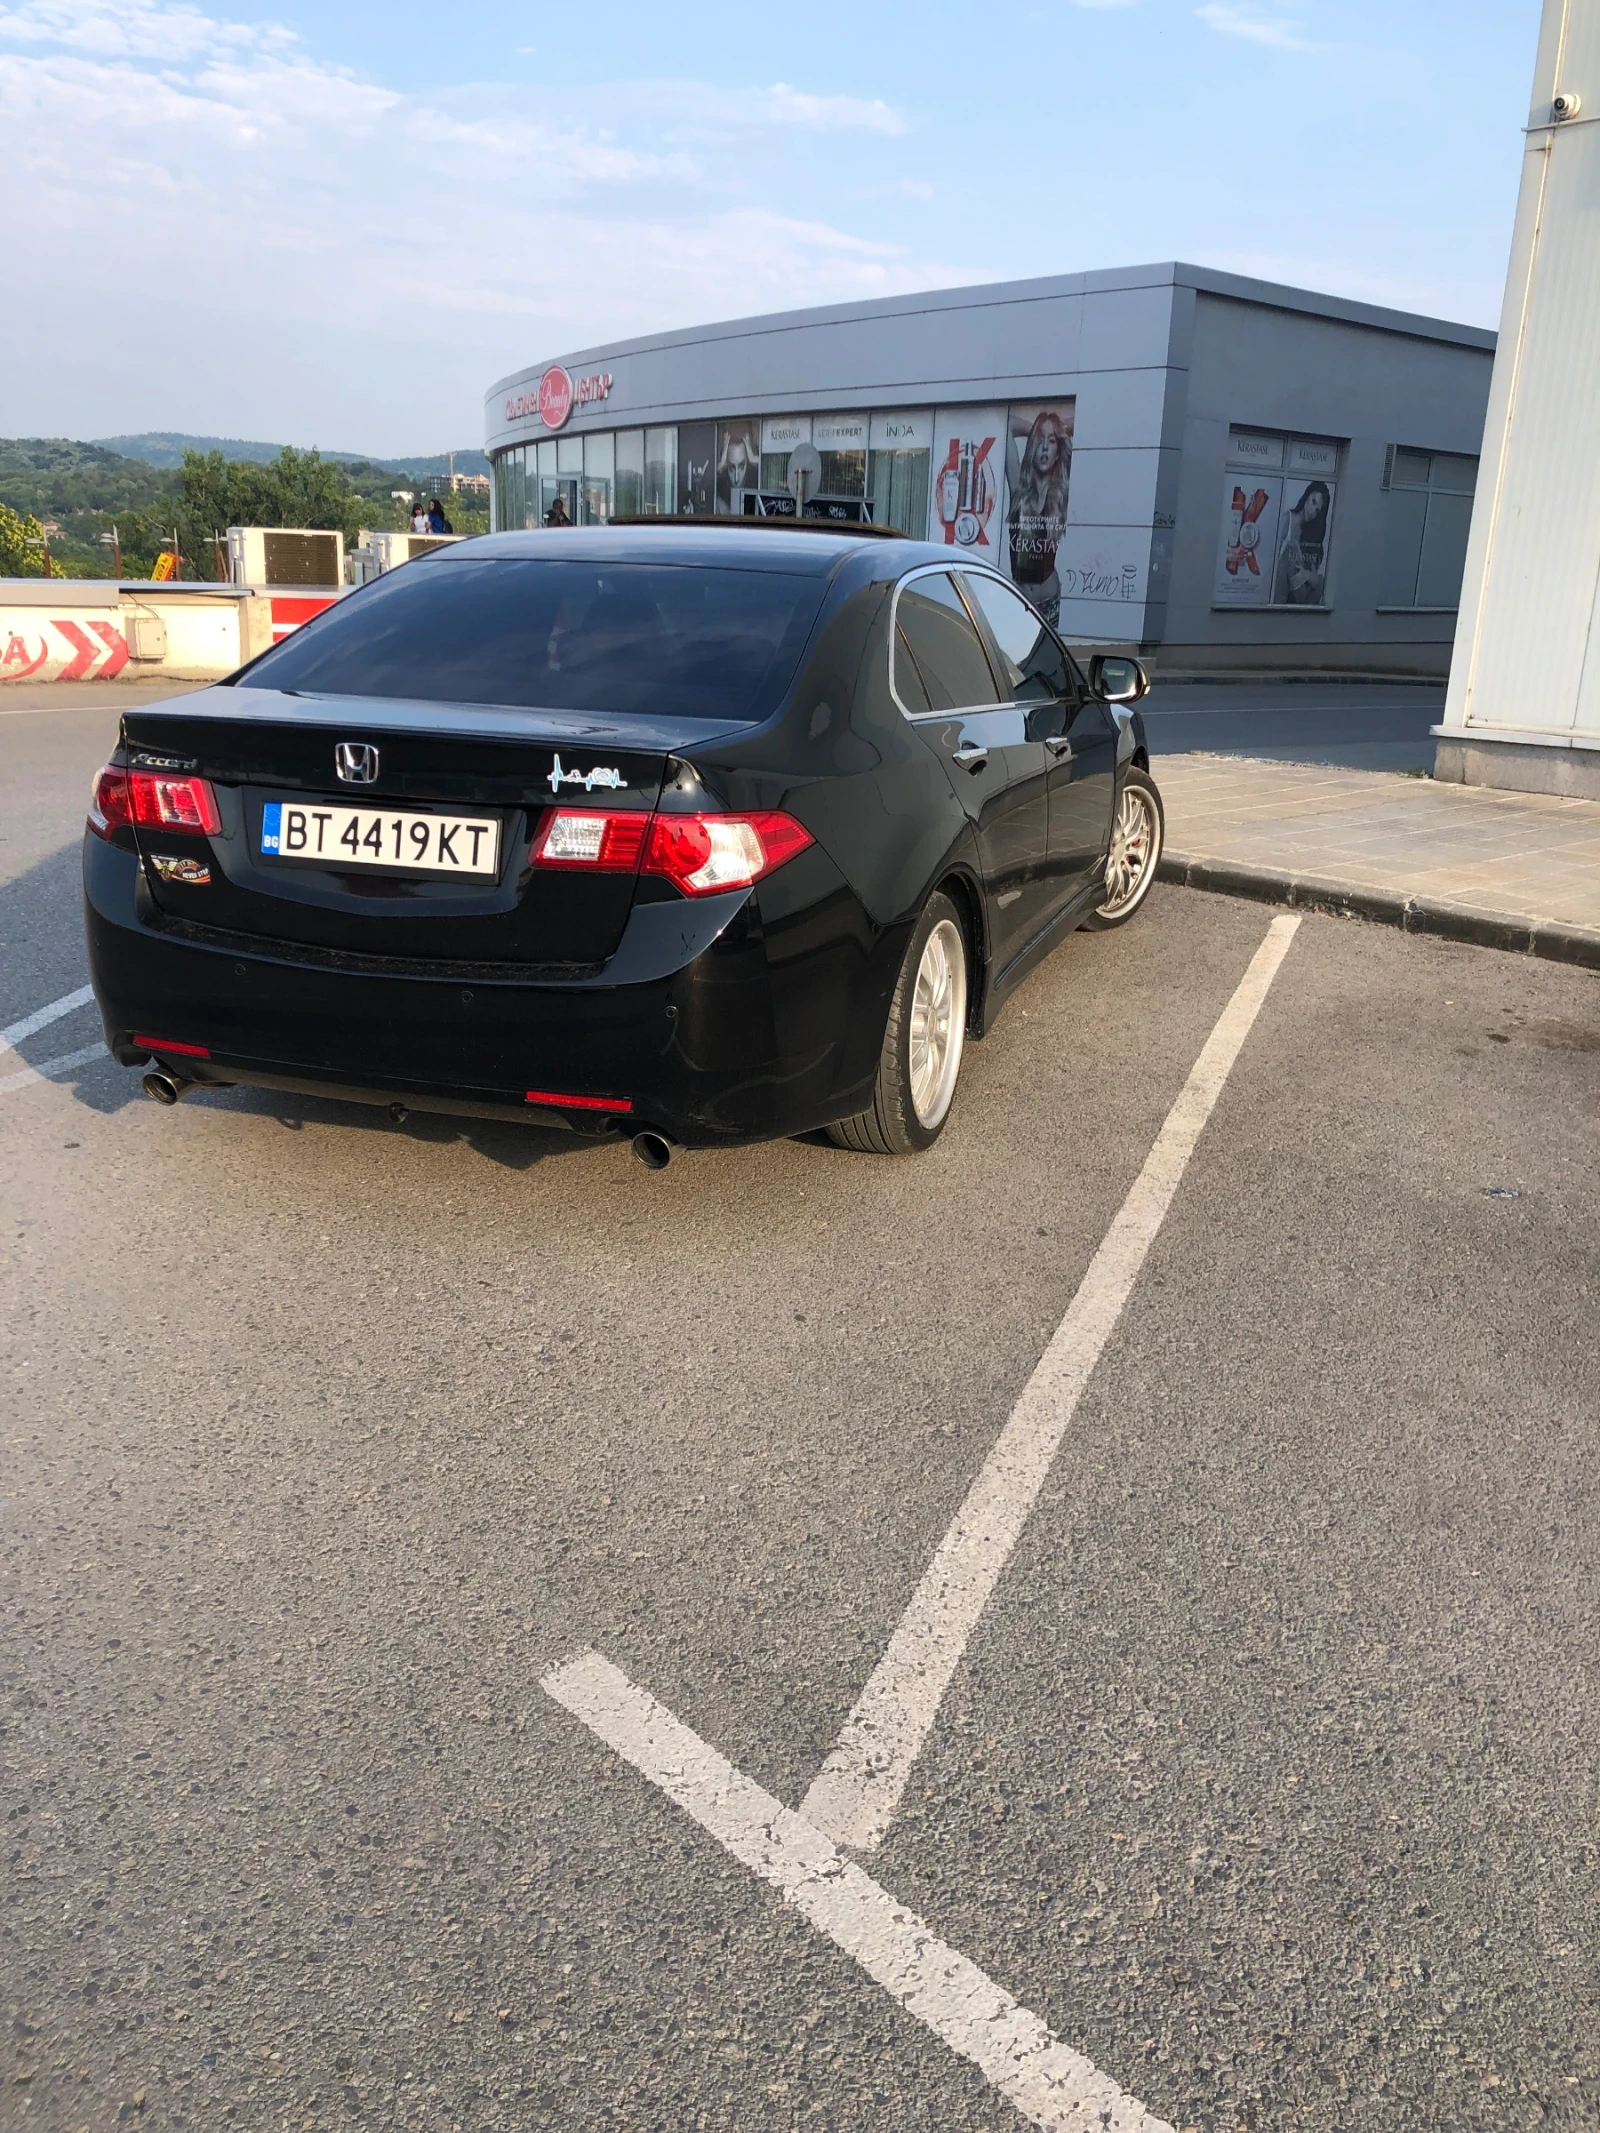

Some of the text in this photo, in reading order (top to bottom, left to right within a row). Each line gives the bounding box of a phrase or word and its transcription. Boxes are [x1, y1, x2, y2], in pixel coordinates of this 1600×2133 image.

[541, 379, 568, 416] Beauty
[131, 753, 198, 770] Accord
[263, 834, 279, 848] BG
[286, 810, 491, 867] BT 4419 KT
